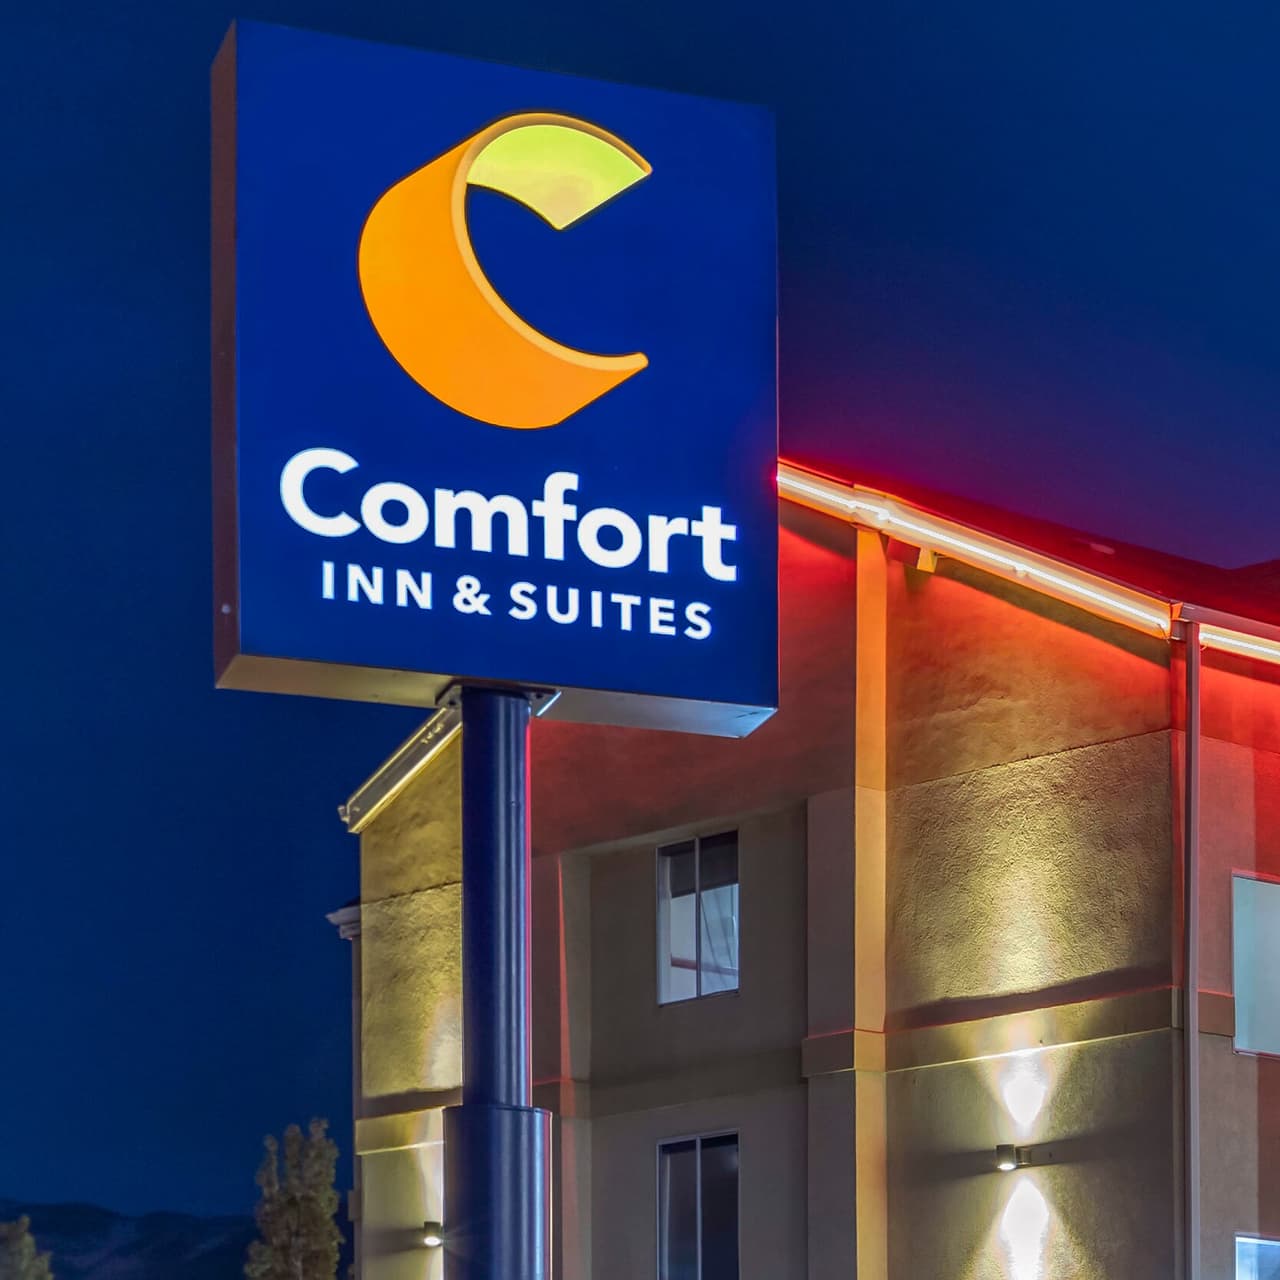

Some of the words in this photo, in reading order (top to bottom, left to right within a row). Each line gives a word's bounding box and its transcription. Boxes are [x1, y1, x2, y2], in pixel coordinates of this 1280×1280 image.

[280, 447, 737, 581] Comfort
[322, 561, 432, 610] INN
[452, 575, 492, 615] &
[508, 581, 712, 640] SUITES
